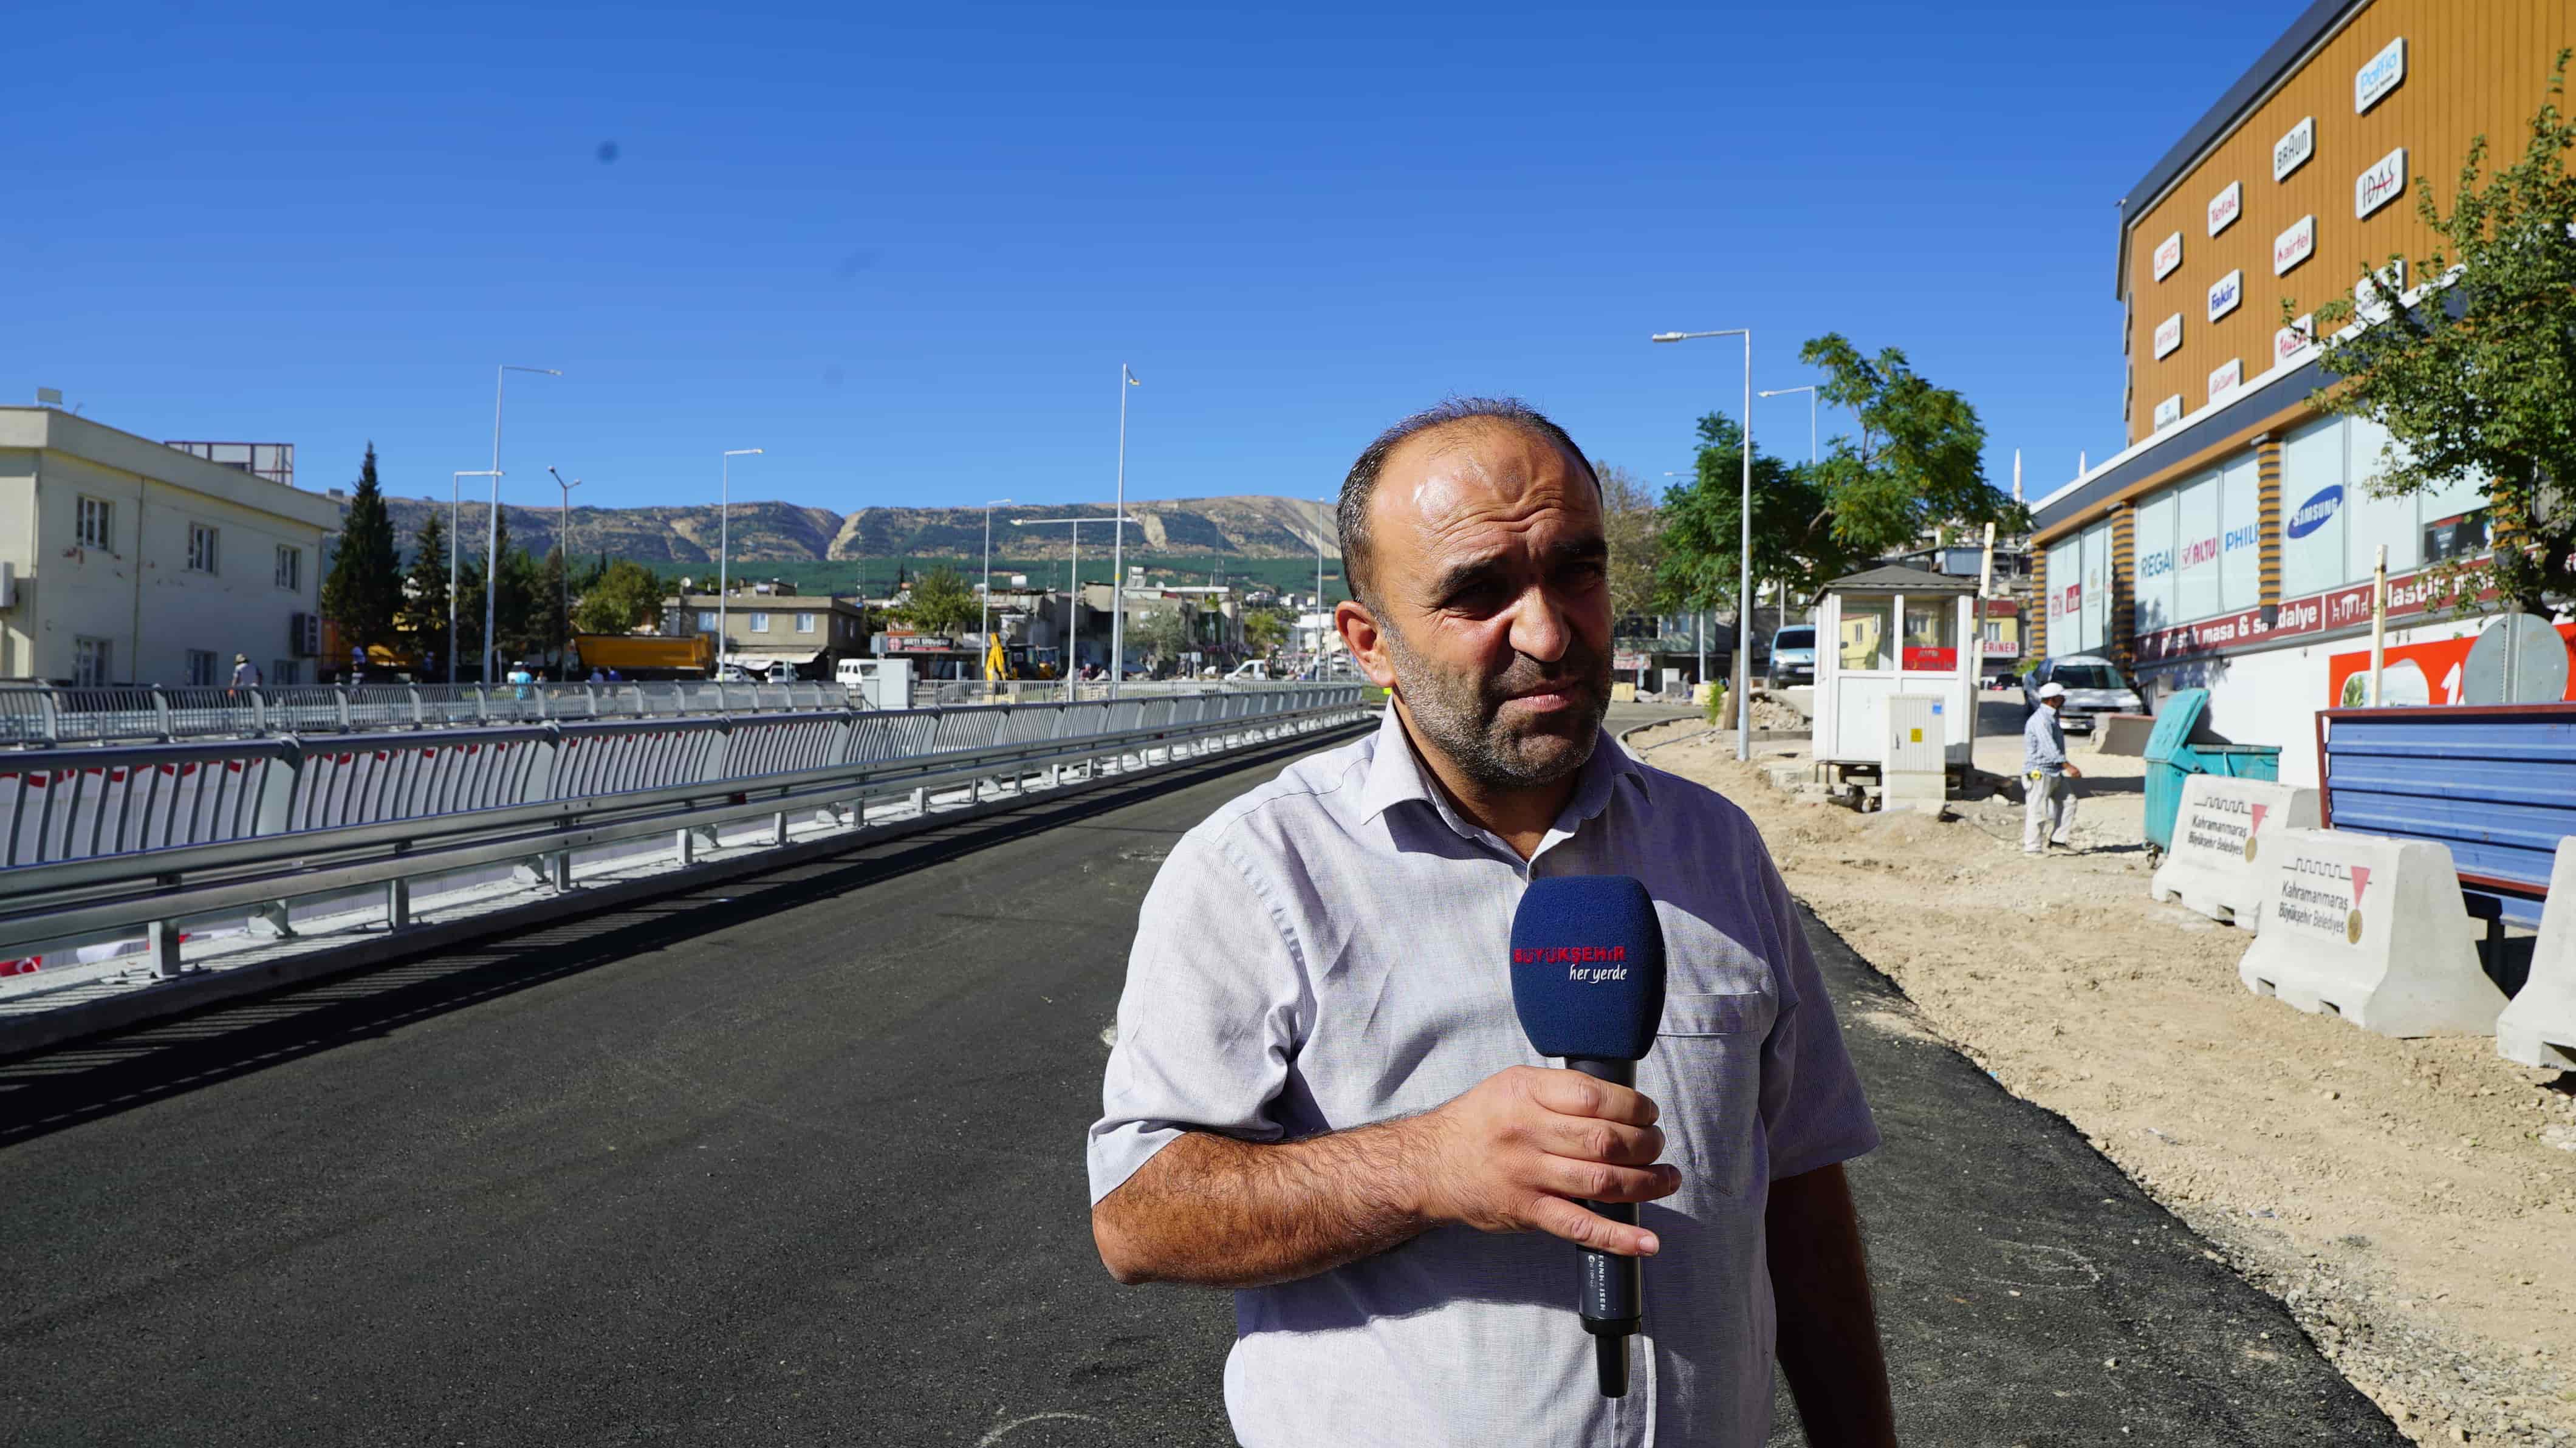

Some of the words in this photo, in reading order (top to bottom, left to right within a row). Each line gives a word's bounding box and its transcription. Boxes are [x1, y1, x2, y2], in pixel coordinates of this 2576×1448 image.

[2211, 192, 2236, 224] Tefal
[2211, 284, 2236, 312] Fakir
[2293, 497, 2338, 527] SAMSUNG
[2193, 537, 2219, 565] ALTU
[2225, 523, 2259, 552] PHILI
[2387, 576, 2446, 608] lastik
[2202, 623, 2235, 644] masa
[2238, 615, 2249, 637] &
[2253, 603, 2318, 633] sadalye
[2191, 814, 2247, 841] Kahramanmaraş
[2281, 880, 2348, 915] Kahramanmaraş
[2279, 901, 2312, 927] Büyükşehir
[2313, 910, 2346, 935] Belediyesi
[1569, 964, 1590, 981] her
[1588, 964, 1628, 984] yerde
